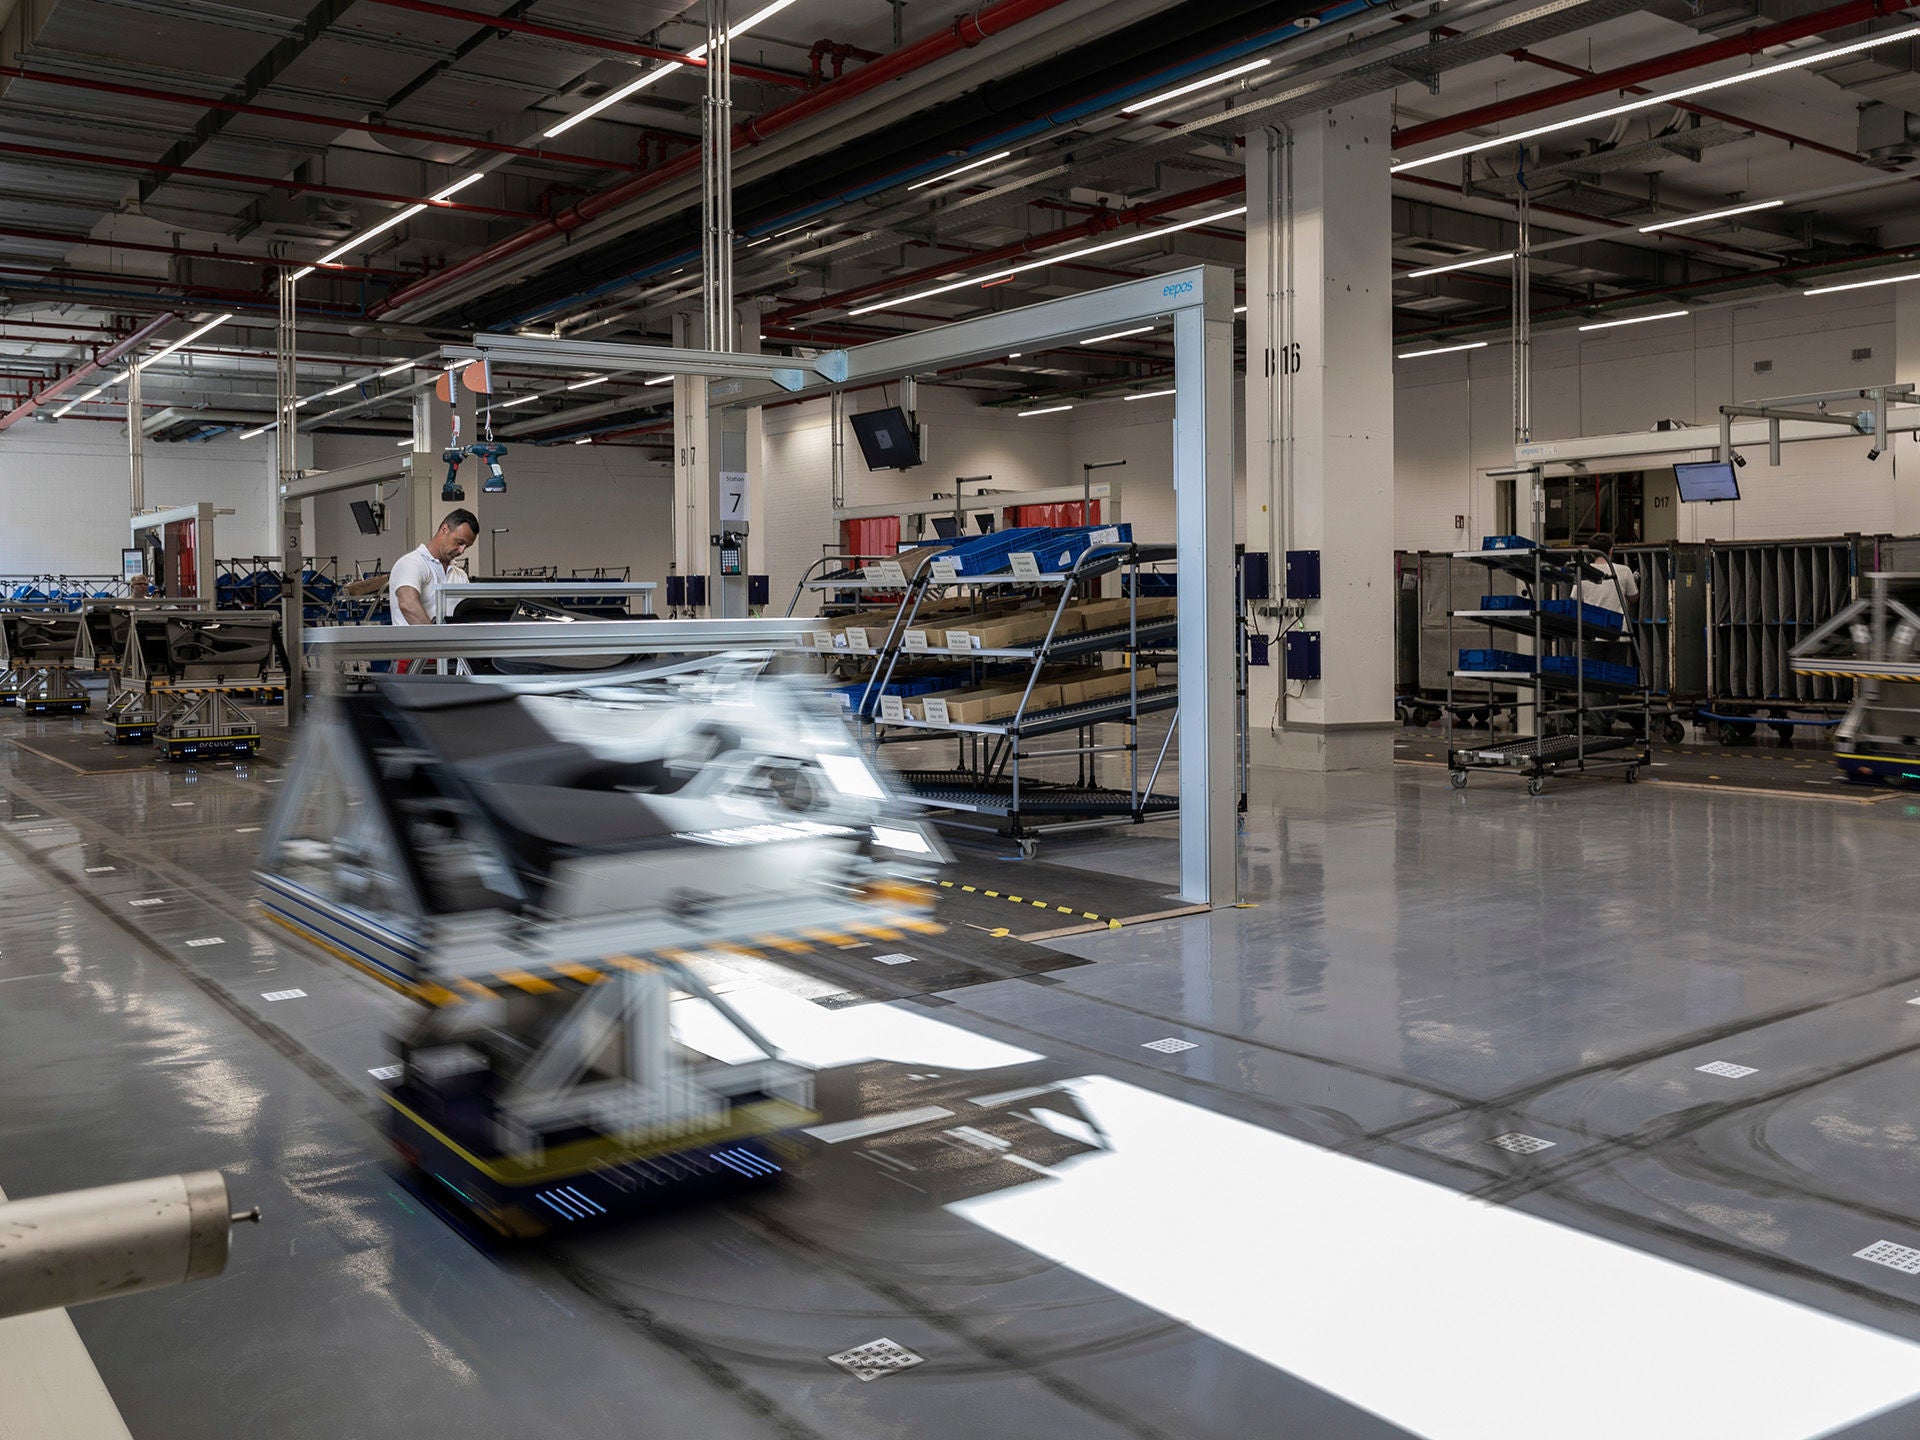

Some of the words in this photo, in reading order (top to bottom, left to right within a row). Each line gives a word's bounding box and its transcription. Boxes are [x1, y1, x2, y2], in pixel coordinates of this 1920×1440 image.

[1163, 280, 1193, 299] eepos
[729, 492, 742, 513] 7
[1654, 496, 1670, 508] D17
[289, 535, 298, 548] 3
